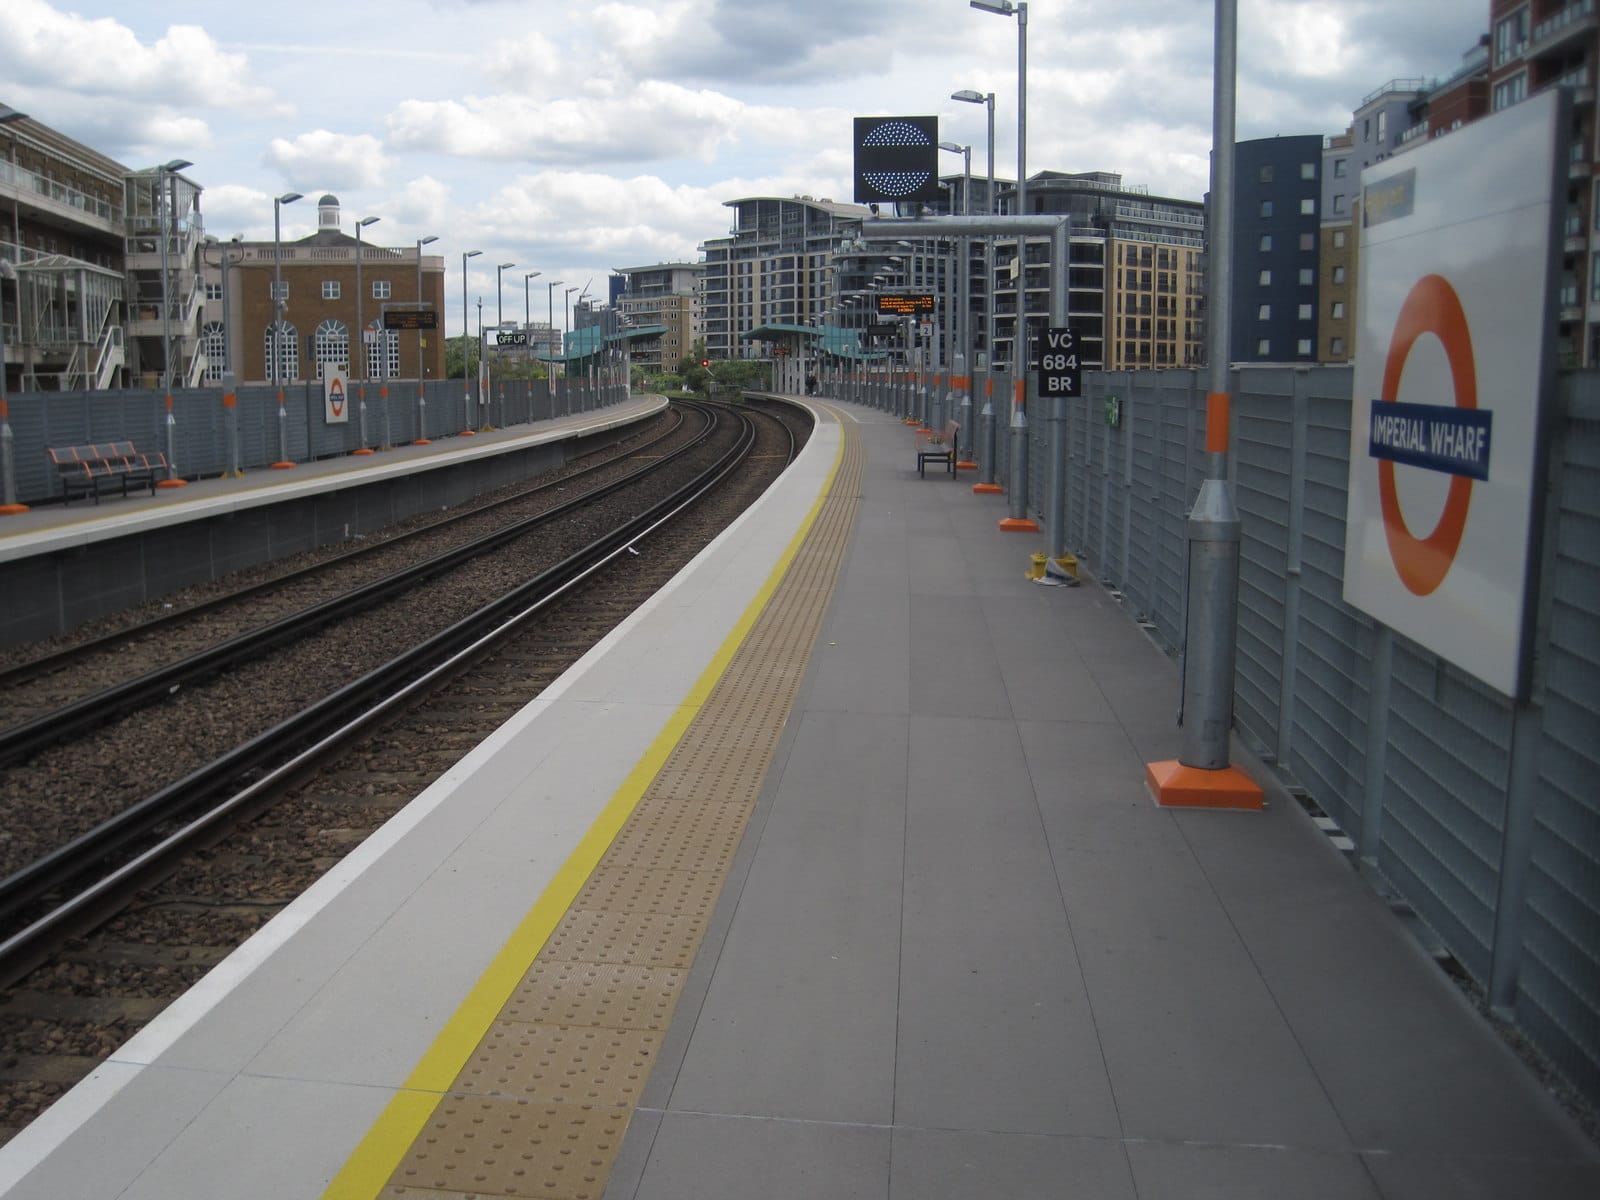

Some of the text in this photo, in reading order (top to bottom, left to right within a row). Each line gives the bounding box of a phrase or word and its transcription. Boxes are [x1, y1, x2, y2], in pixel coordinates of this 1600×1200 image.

[923, 327, 929, 335] 2
[498, 334, 526, 344] OFF UP
[1047, 333, 1073, 348] VC
[1042, 354, 1078, 370] 684
[1048, 376, 1072, 391] BR
[1373, 415, 1486, 462] IMPERIAL WHARF
